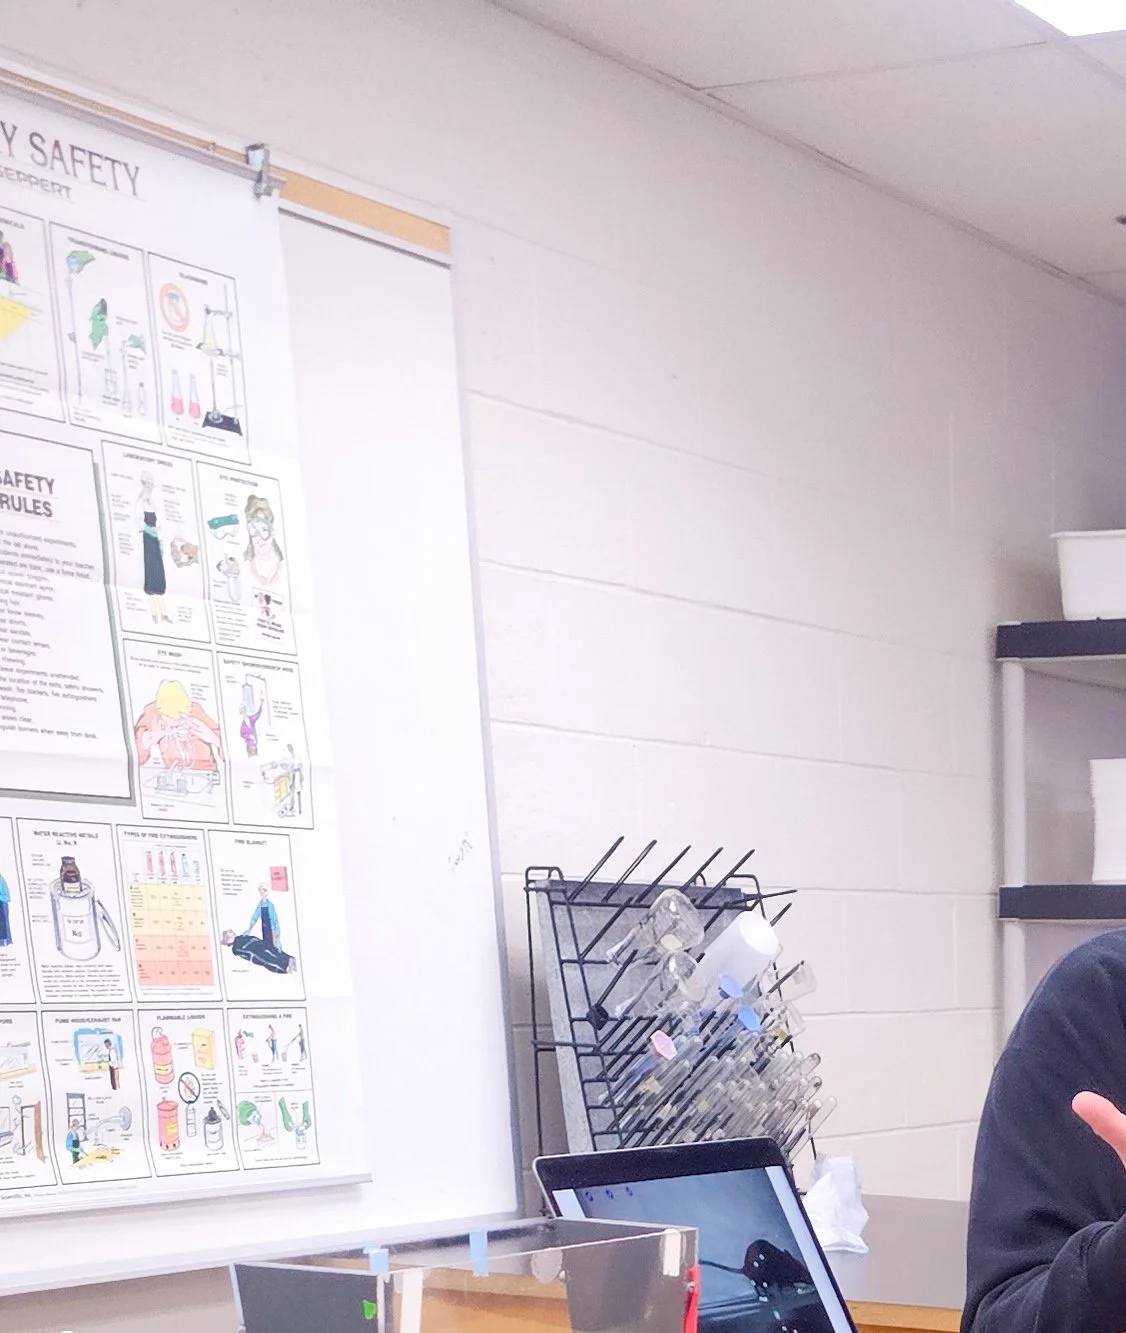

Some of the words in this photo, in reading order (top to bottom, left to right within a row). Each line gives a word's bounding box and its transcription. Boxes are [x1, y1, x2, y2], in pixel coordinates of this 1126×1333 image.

[28, 131, 140, 196] SAFETY
[0, 469, 55, 494] AFETY
[0, 492, 53, 518] RULES
